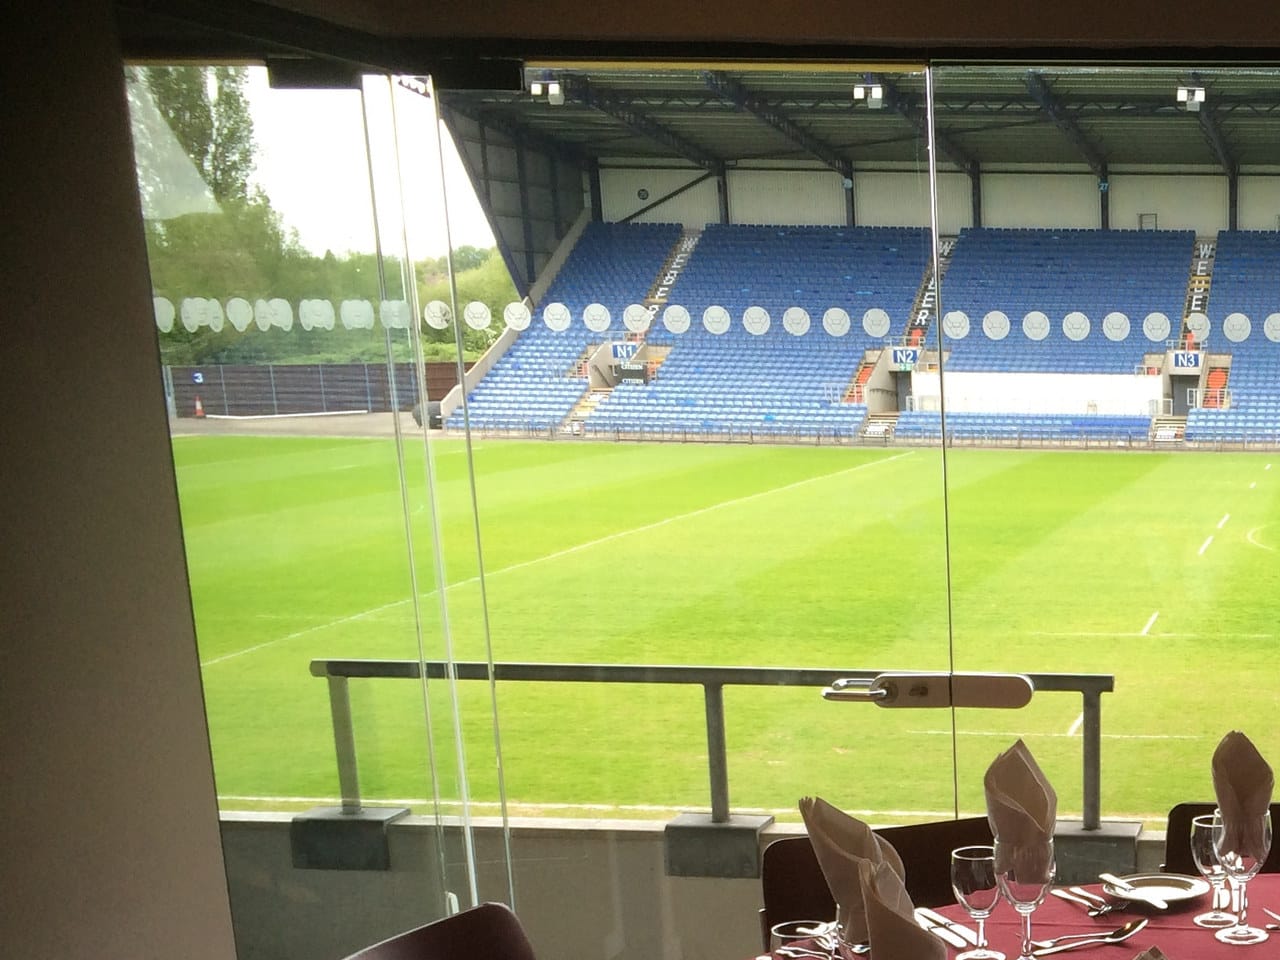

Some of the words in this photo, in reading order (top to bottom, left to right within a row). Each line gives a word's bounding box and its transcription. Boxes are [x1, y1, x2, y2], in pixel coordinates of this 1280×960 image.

[616, 345, 633, 358] N1
[896, 350, 914, 364] N2
[1178, 354, 1196, 368] N3
[193, 372, 204, 384] 3
